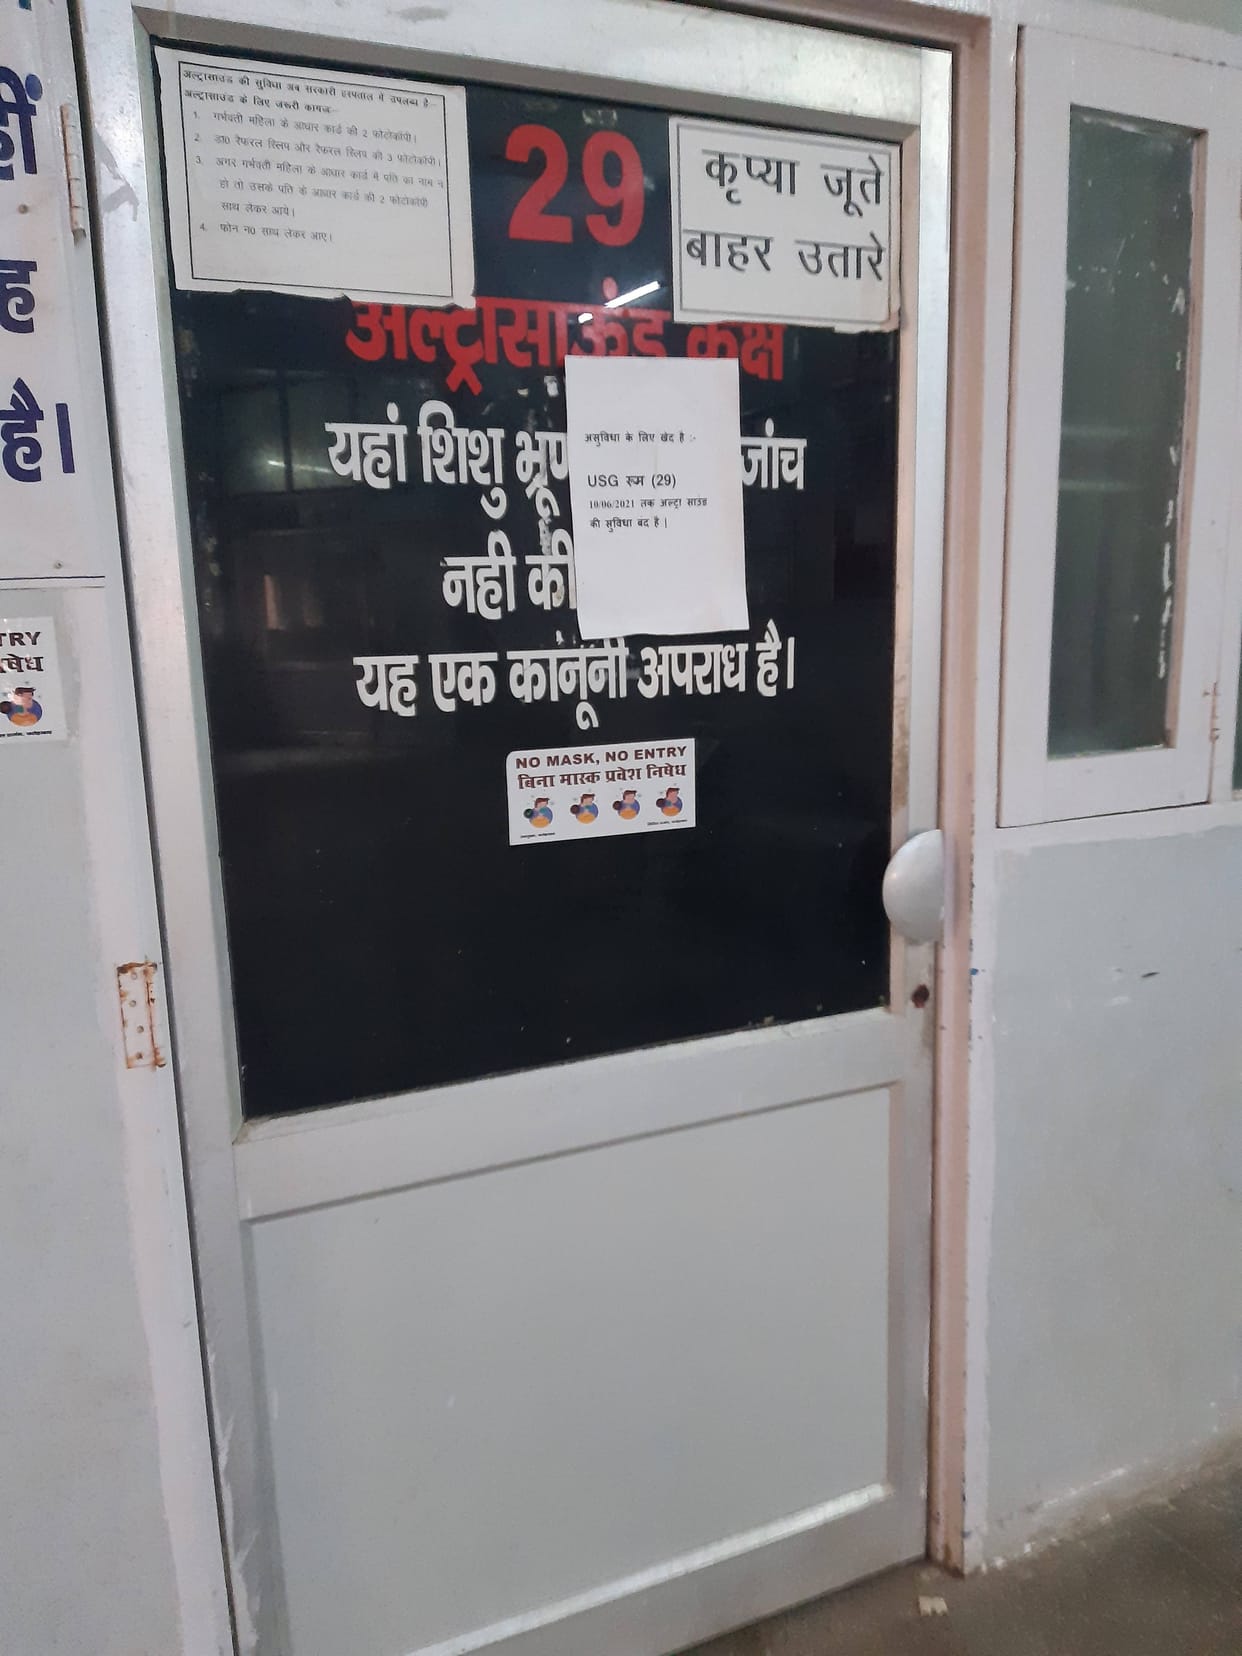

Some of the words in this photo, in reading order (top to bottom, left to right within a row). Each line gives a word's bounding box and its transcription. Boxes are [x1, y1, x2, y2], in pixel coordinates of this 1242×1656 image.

[239, 75, 250, 86] की
[255, 78, 282, 91] सुविधा
[287, 82, 300, 92] अब
[305, 83, 336, 97] सरकारी
[239, 94, 248, 104] के
[253, 95, 270, 108] लिए
[275, 99, 300, 111] जरूरी
[213, 109, 243, 124] गर्भवती
[249, 112, 275, 127] महिला
[280, 117, 289, 128] के
[294, 120, 319, 132] आधार
[325, 122, 342, 135] कार्ड
[347, 125, 358, 137] की
[362, 129, 368, 138] 2
[268, 136, 290, 151] स्लिप
[295, 141, 310, 153] और
[346, 145, 367, 159] स्लिप
[372, 149, 383, 161] की
[387, 153, 393, 162] 3
[216, 157, 237, 168] अगर
[242, 157, 271, 170] गर्भवती
[276, 160, 302, 174] महिला
[307, 164, 316, 175] के
[321, 166, 345, 178] आधार
[350, 168, 368, 180] कार्ड
[384, 170, 398, 183] पति
[402, 176, 414, 185] का
[418, 177, 433, 187] नाम
[219, 178, 229, 189] हो
[234, 178, 244, 190] तो
[249, 180, 273, 192] उसके
[278, 181, 294, 194] पति
[299, 184, 308, 196] के
[312, 188, 337, 199] आधार
[342, 188, 360, 201] कार्ड
[365, 191, 376, 203] की
[379, 195, 385, 204] 2
[505, 123, 646, 248] 29
[820, 155, 885, 218] जूते
[221, 201, 240, 212] साथ
[245, 201, 267, 214] लेकर
[220, 221, 239, 233] फोन
[261, 226, 279, 237] साथ
[284, 227, 306, 239] लेकर
[683, 228, 774, 272] बाहर
[795, 231, 886, 281] उतारे
[585, 430, 620, 447] असुविधा
[625, 430, 633, 442] के
[638, 430, 655, 443] लिए
[660, 431, 674, 443] खेद
[679, 429, 684, 443] है
[325, 402, 407, 489] यहां
[417, 400, 507, 519] शिशु
[741, 418, 808, 490] जांच
[587, 474, 619, 488] USG
[625, 474, 645, 487] रूम
[651, 473, 677, 489] (29)
[590, 499, 635, 509] 10/06/2021
[640, 498, 655, 508] तक
[660, 498, 682, 510] अल्ट्रा
[590, 516, 601, 529] की
[605, 516, 632, 533] सुविधा
[442, 531, 516, 620] नही
[353, 654, 419, 717] यह
[428, 651, 499, 711] एक
[637, 643, 749, 700] अपराध
[515, 757, 541, 769] NO
[546, 753, 600, 767] MASK,
[605, 751, 629, 763] NO
[634, 745, 687, 760] ENTRY
[518, 773, 555, 789] बिना
[559, 771, 600, 786] मास्क
[605, 767, 642, 782] प्रवेश
[646, 763, 687, 779] निषेध
